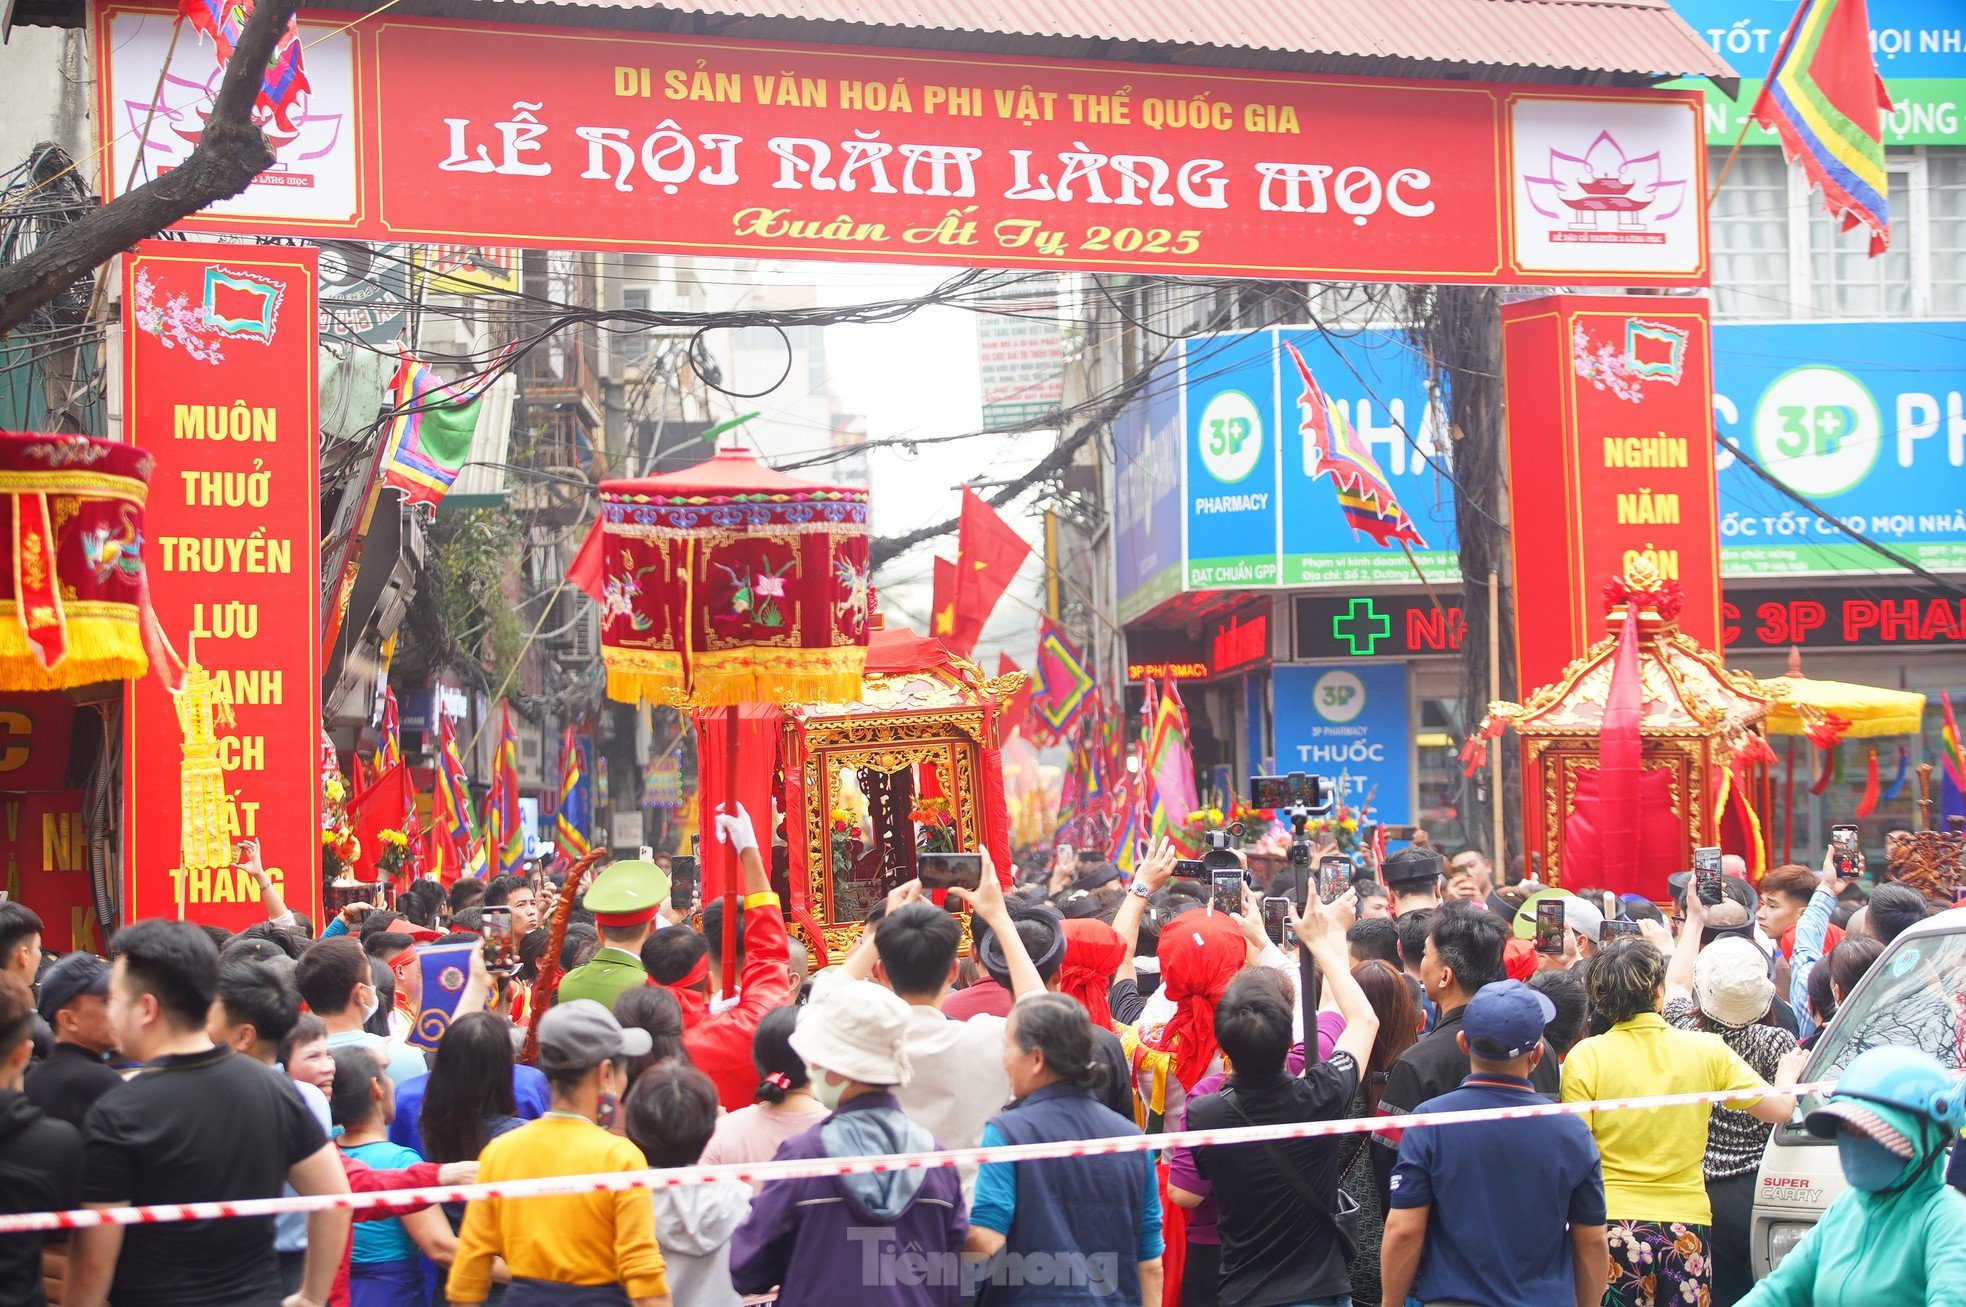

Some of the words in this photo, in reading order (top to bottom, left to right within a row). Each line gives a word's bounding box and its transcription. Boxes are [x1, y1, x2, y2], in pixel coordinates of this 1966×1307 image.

[1706, 18, 1772, 53] TỐT
[614, 66, 651, 99] DI
[664, 59, 741, 103] SẢN
[753, 70, 827, 108] VĂN
[840, 77, 912, 113] HOÁ
[923, 85, 982, 117] PHI
[994, 86, 1058, 126] VẬT
[1068, 85, 1131, 126] THỂ
[1143, 91, 1233, 132] QUỐC
[1244, 105, 1300, 134] GIA
[438, 101, 552, 176] LỄ
[575, 118, 744, 195] HỘI
[767, 129, 983, 197] NĂM
[1003, 141, 1229, 209] LÀNG
[1253, 162, 1436, 227] MỌC
[732, 207, 891, 244] Xuân
[902, 206, 980, 248] Ất
[1079, 226, 1203, 256] 2025
[174, 399, 277, 442] MUÔN
[1209, 417, 1251, 456] 3P
[1775, 404, 1859, 457] 3P
[1603, 431, 1688, 468] NGHÌN
[181, 458, 272, 508] THUỞ
[1195, 493, 1268, 515] PHARMACY
[1617, 488, 1679, 524] NĂM
[1762, 510, 1810, 536] TỐT
[1871, 515, 1915, 537] MỌI
[1919, 510, 1966, 533] NHÀ
[159, 526, 291, 573] TRUYỀN
[1302, 557, 1333, 568] Phạm
[1336, 557, 1345, 566] vi
[1349, 556, 1370, 566] kinh
[1192, 567, 1214, 583] ĐẠT
[1216, 560, 1253, 582] CHUẦN
[1255, 563, 1277, 580] GPP
[194, 600, 258, 639] LƯU
[1755, 601, 1826, 644] 3P
[202, 669, 283, 705] ANH
[219, 735, 265, 771] CH
[1296, 738, 1384, 763] THUỐC
[224, 789, 260, 837] ẤT
[1762, 1187, 1823, 1202] CARRY
[1763, 1177, 1810, 1188] SUPER
